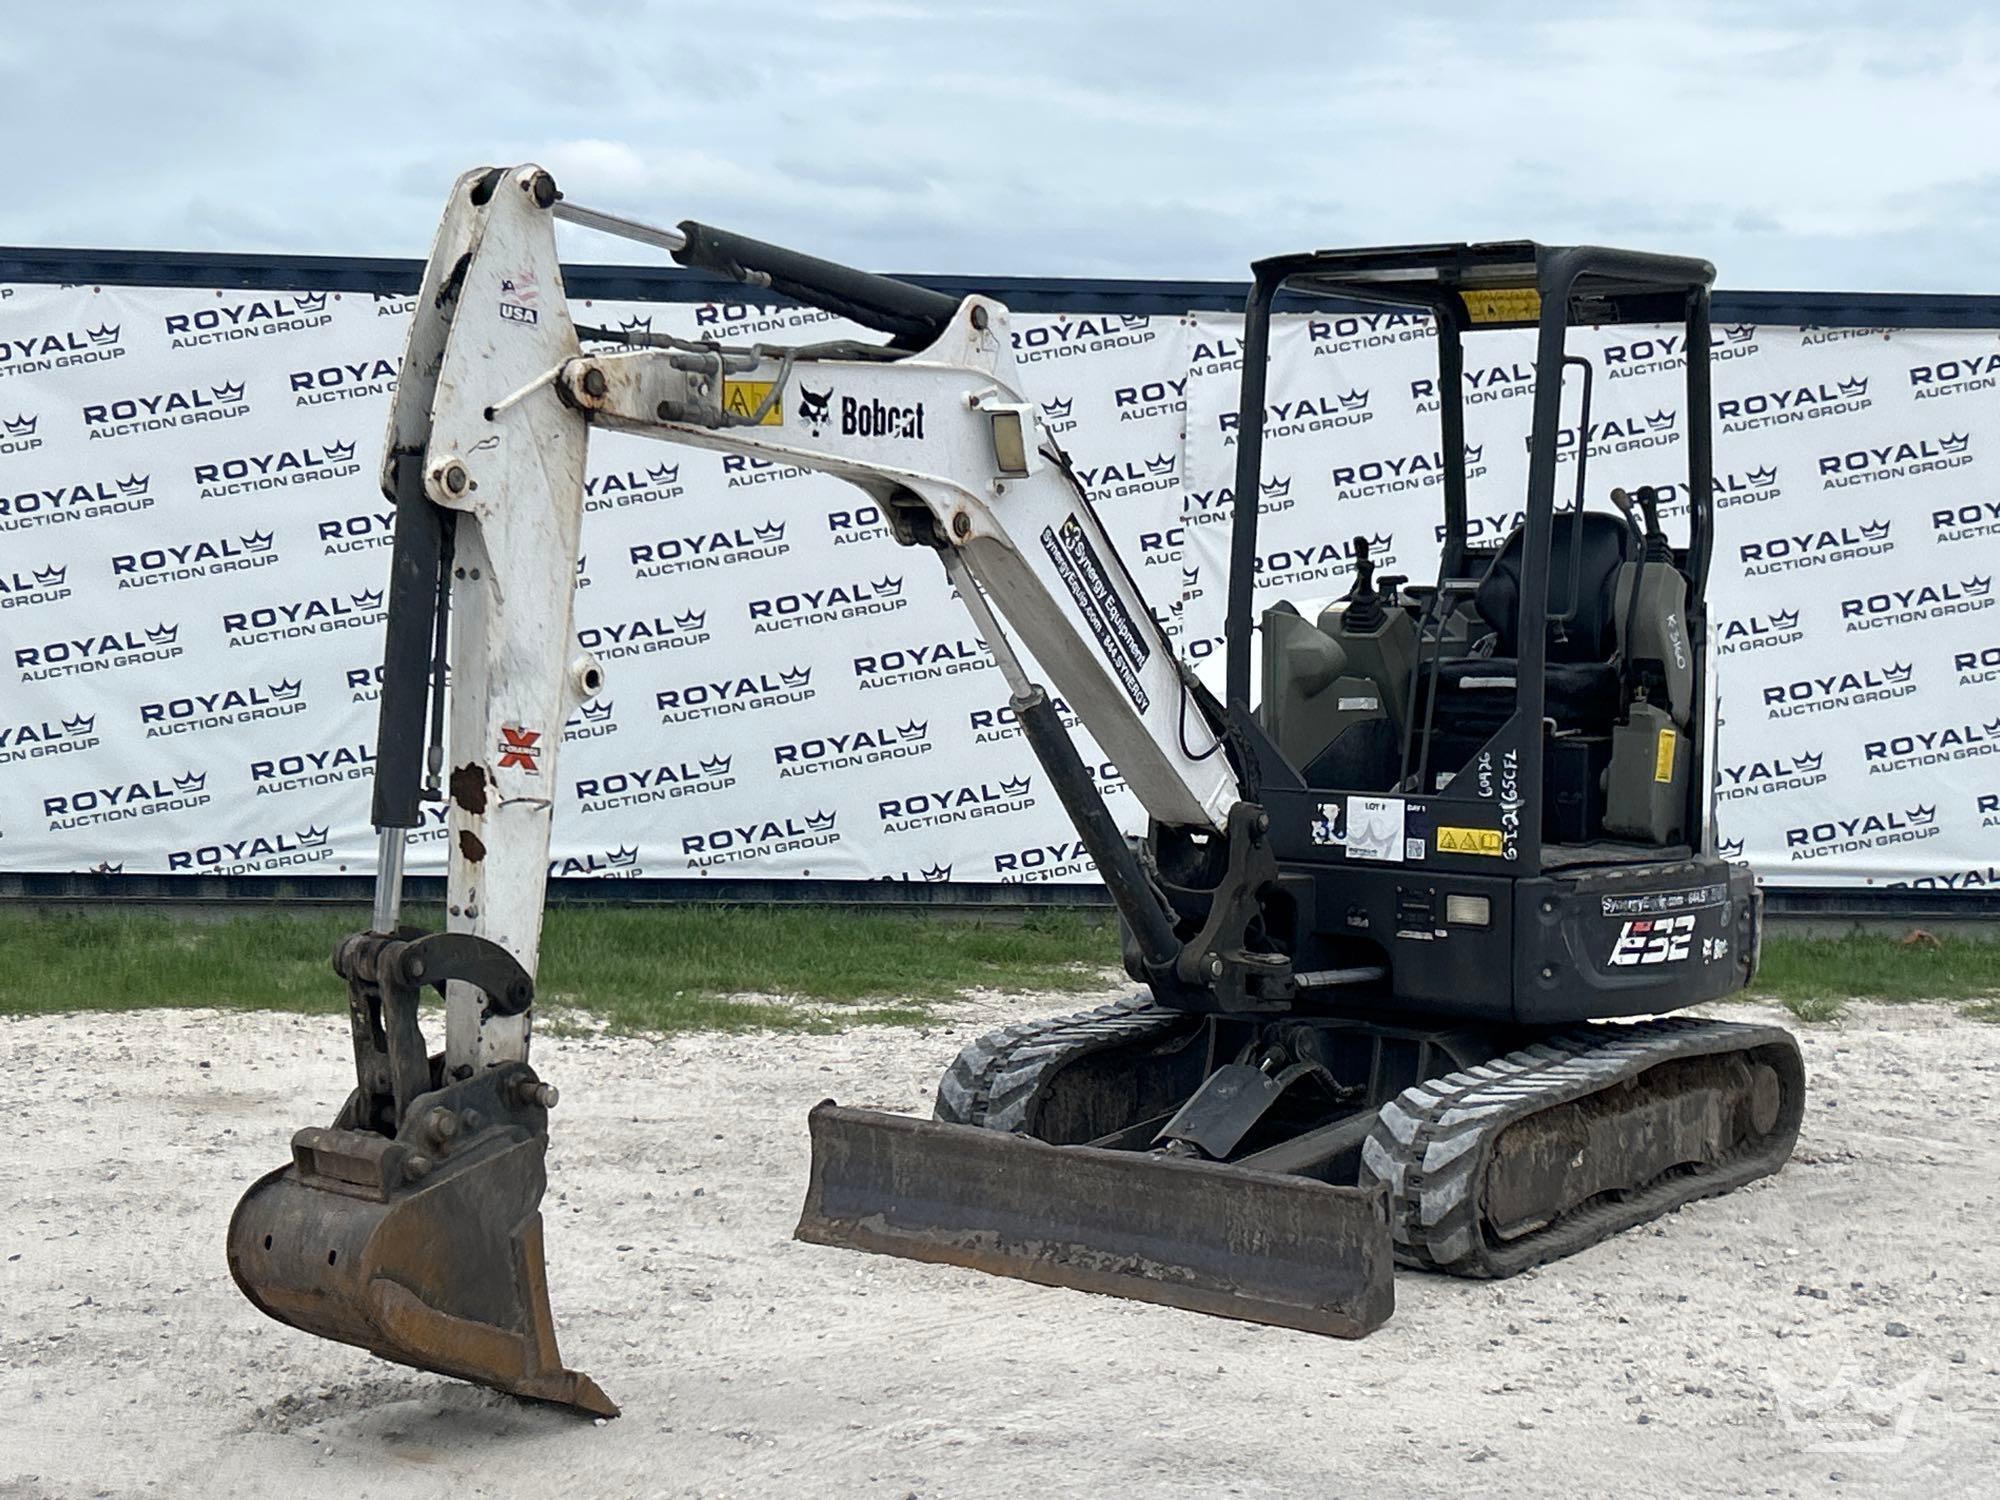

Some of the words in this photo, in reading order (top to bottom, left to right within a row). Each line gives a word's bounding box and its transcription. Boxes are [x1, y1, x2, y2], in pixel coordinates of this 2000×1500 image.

[164, 298, 296, 334] ROYAL
[501, 304, 536, 323] USA
[700, 318, 785, 342] AUCTION
[171, 326, 260, 350] AUCTION
[262, 314, 333, 335] GROUP
[1016, 343, 1087, 365] UCTION
[1090, 332, 1156, 352] GROUP
[1313, 333, 1397, 356] AUCTION
[1398, 325, 1436, 342] GRO
[0, 359, 53, 376] TION
[55, 347, 126, 368] GROUP
[1710, 344, 1759, 363] ROUP
[1909, 352, 2000, 386] ROYA
[289, 359, 403, 393] ROYA
[1114, 376, 1188, 408] ROY
[1410, 364, 1532, 400] RYAL
[1914, 376, 1996, 400] AUCTION
[82, 389, 213, 426] ROYAL
[296, 383, 384, 408] AUCTION
[1119, 400, 1187, 422] AUCTIO
[1717, 384, 1839, 420] ROYAL
[89, 416, 177, 441] AUCTION
[180, 404, 250, 425] GROUP
[842, 396, 925, 440] Bobcat
[1218, 397, 1339, 432] RYAL
[1308, 411, 1373, 432] GROUP
[1722, 411, 1805, 434] AUCTION
[1807, 398, 1873, 419] GROUP
[0, 438, 43, 454] OUP
[1615, 432, 1680, 453] GROUP
[1818, 440, 1940, 476] ROYAL
[193, 448, 324, 485] ROYAL
[200, 475, 288, 500] AUCTION
[291, 463, 361, 484] GROUP
[585, 471, 648, 497] YAL
[728, 465, 812, 489] AUCTION
[1077, 462, 1146, 488] YAL
[1823, 467, 1906, 490] AUCTION
[1908, 454, 1974, 475] GROUP
[616, 486, 685, 507] GROUP
[1114, 477, 1180, 498] GROUP
[1337, 478, 1420, 501] AUCTION
[1716, 488, 1781, 509] GROUP
[84, 497, 156, 518] GROUP
[317, 509, 397, 542] ROY
[1931, 500, 2000, 531] ROY
[323, 535, 395, 556] AUCTIO
[629, 529, 755, 565] ROYAL
[833, 527, 891, 545] AUCTI
[1739, 527, 1861, 564] ROYAL
[1936, 523, 2000, 544] AUCTIO
[111, 538, 242, 576] ROYAL
[118, 565, 206, 591] AUCTION
[209, 554, 279, 575] GROUP
[635, 556, 720, 579] AUCTION
[723, 543, 790, 565] GROUP
[1744, 554, 1827, 577] AUCTION
[1829, 541, 1895, 562] GROUP
[1, 587, 73, 609] GROUP
[222, 595, 353, 633] ROYAL
[748, 583, 873, 620] ROYAL
[754, 610, 838, 634] AUCTION
[841, 598, 907, 620] GROUP
[1074, 542, 1108, 599] Synergy
[1104, 594, 1147, 670] Equipment
[1840, 583, 1962, 619] ROYAL
[1846, 610, 1928, 633] AUCTION
[1930, 597, 1996, 618] GROUP
[229, 623, 317, 649] AUCTION
[319, 611, 389, 632] GROUP
[573, 617, 675, 649] OYAL
[594, 644, 640, 661] TION
[643, 632, 710, 654] GROUP
[1739, 631, 1804, 652] GROUP
[14, 631, 146, 669] ROYAL
[21, 658, 110, 684] AUCTION
[113, 646, 183, 668] GROUP
[853, 641, 978, 677] ROYAL
[858, 666, 943, 691] AUCTION
[946, 657, 997, 676] GROU
[1763, 670, 1884, 706] ROYAL
[139, 686, 270, 724] ROYAL
[655, 674, 781, 712] ROYAL
[661, 701, 746, 725] AUCTION
[749, 688, 816, 710] GROUP
[1768, 696, 1850, 719] AUCTION
[1852, 684, 1918, 705] GROUP
[146, 714, 234, 739] AUCTION
[237, 701, 307, 723] GROUP
[563, 722, 618, 742] ROUP
[30, 737, 101, 759] GROUP
[774, 727, 897, 765] ROYAL
[779, 753, 863, 779] AUCTION
[867, 741, 933, 764] GROUP
[1863, 725, 1984, 761] ROYAL
[575, 762, 701, 799] ROYAL
[1716, 758, 1794, 784] YAL
[1869, 751, 1950, 775] AUCTION
[42, 778, 174, 817] ROYAL
[255, 771, 344, 796] AUCTION
[581, 789, 666, 813] AUCTION
[669, 776, 736, 799] GROUP
[1716, 784, 1759, 802] TION
[1762, 773, 1828, 794] GROUP
[48, 807, 138, 832] AUCTION
[141, 794, 211, 815] GROUP
[878, 784, 1001, 821] ROYAL
[883, 810, 967, 834] AUCTION
[970, 798, 1036, 819] GROUP
[681, 819, 806, 856] ROYAL
[1786, 812, 1907, 848] ROYAL
[1791, 838, 1872, 861] AUCTION
[1875, 826, 1941, 847] GROUP
[167, 834, 298, 872] ROYAL
[264, 847, 335, 870] GROUP
[686, 845, 771, 869] AUCTION
[775, 833, 841, 854] GROUP
